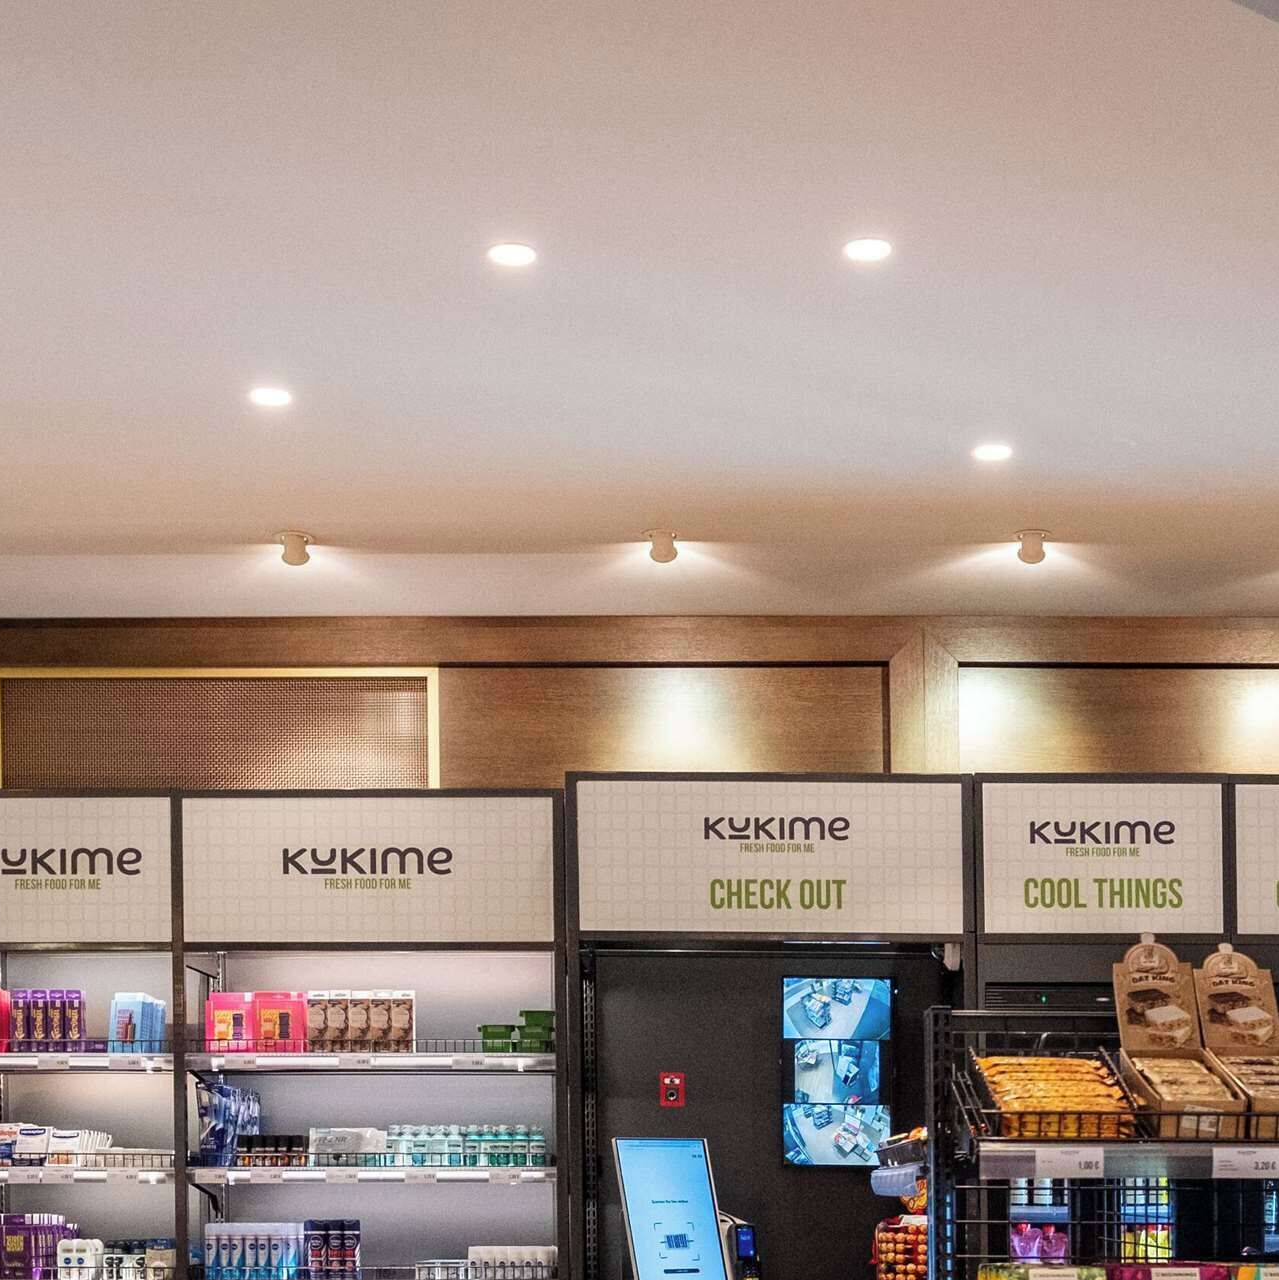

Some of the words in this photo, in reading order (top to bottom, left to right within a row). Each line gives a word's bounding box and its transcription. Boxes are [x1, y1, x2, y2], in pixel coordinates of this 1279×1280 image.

[739, 842, 764, 853] FRESH
[765, 842, 785, 853] FOOD
[787, 842, 802, 853] FOR
[803, 842, 815, 853] ME
[1065, 846, 1090, 858] FRESH
[1091, 846, 1111, 858] FOOD
[1112, 846, 1127, 858] FOR
[1128, 846, 1140, 858] ME
[14, 878, 43, 890] FRESH
[44, 878, 67, 890] FOOD
[69, 878, 86, 890] FOR
[88, 878, 101, 890] ME
[324, 877, 353, 890] FRESH
[355, 877, 378, 890] FOOD
[379, 877, 396, 890] FOR
[398, 877, 412, 890] ME
[710, 878, 792, 910] CHECK
[800, 878, 847, 910] OUT
[1023, 878, 1086, 909] COOL
[1093, 878, 1183, 909] THINGS
